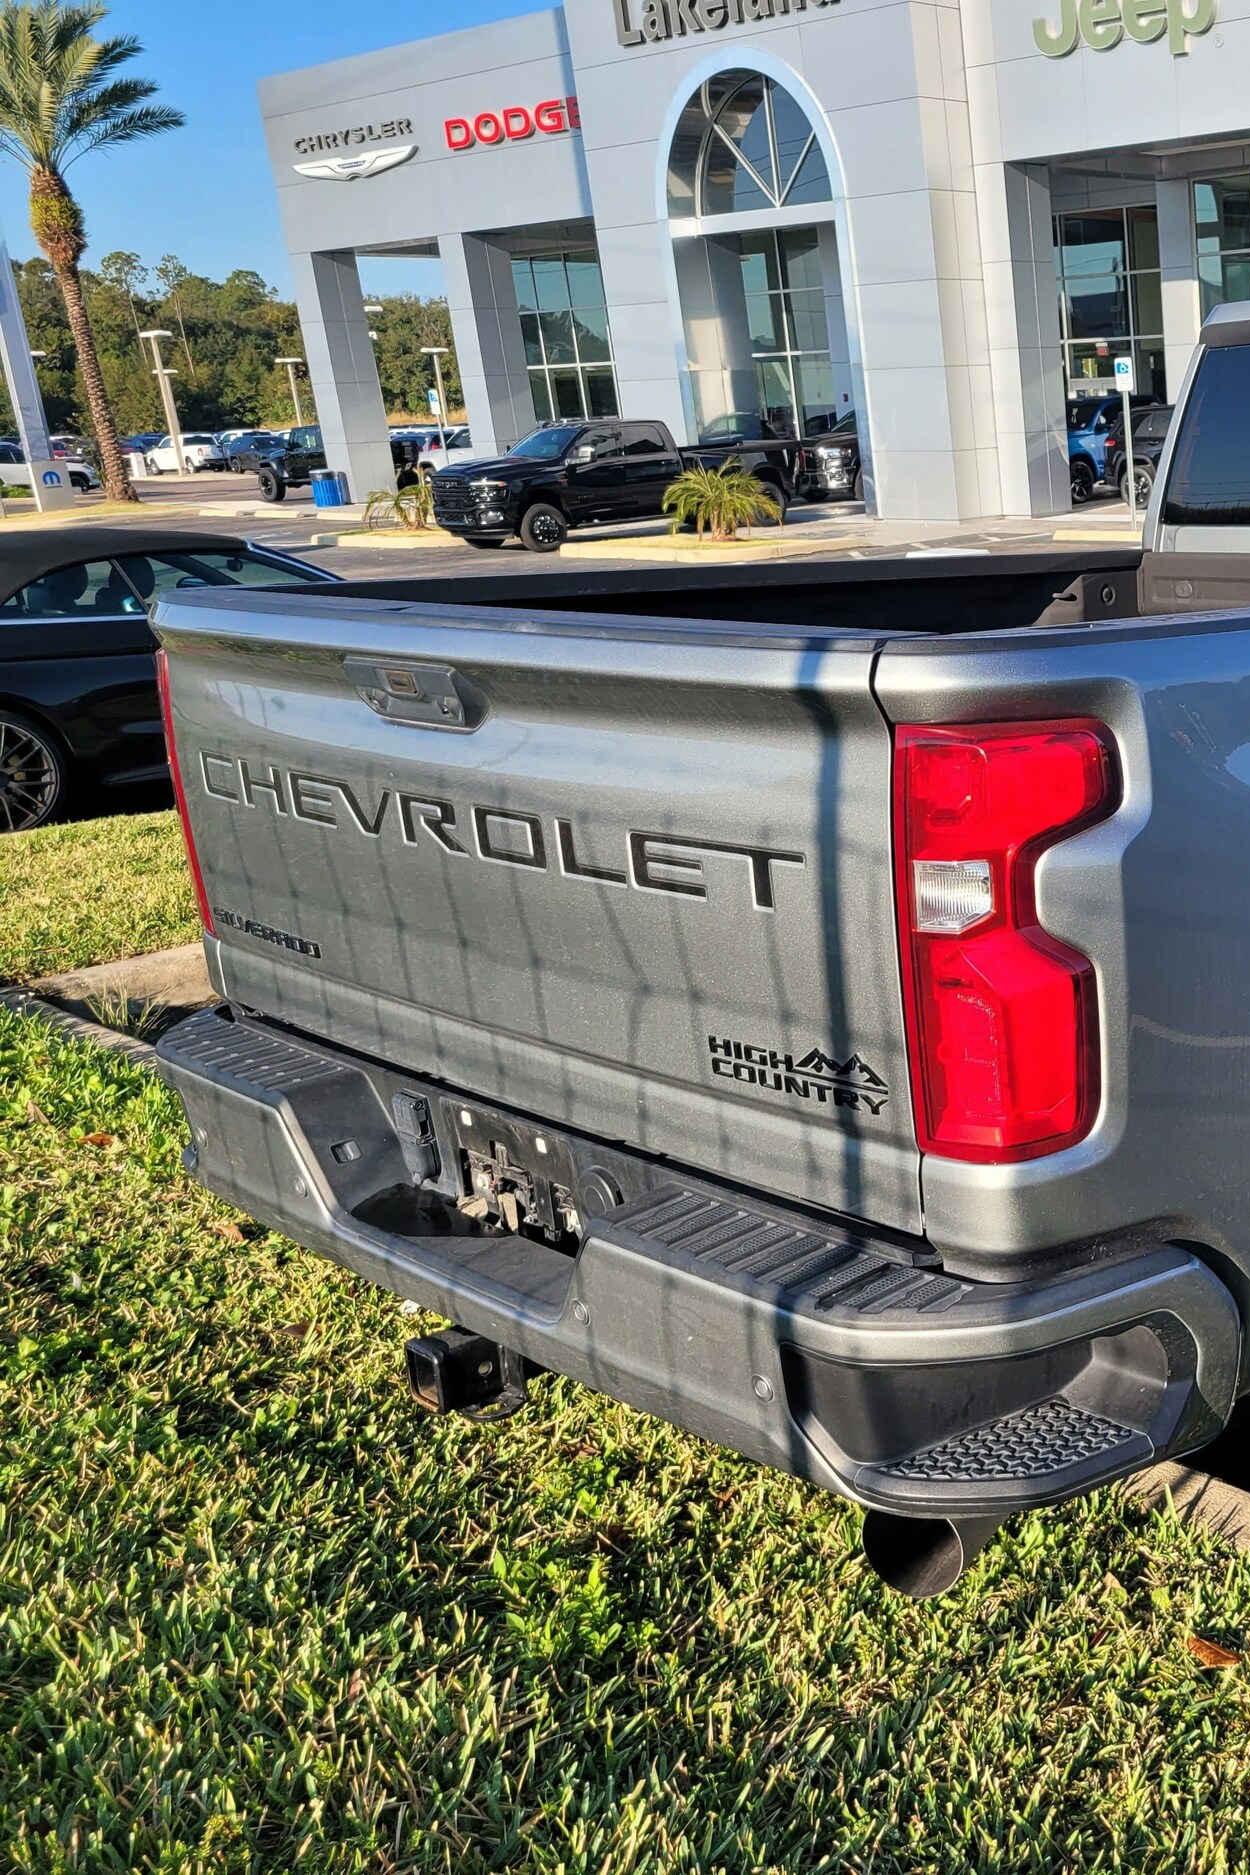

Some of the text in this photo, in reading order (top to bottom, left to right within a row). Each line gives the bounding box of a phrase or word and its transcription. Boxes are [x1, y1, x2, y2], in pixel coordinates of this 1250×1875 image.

[612, 0, 838, 46] Lake
[1032, 0, 1215, 57] Jeep
[294, 119, 413, 154] CHRYSLER
[444, 96, 581, 149] DODGE
[200, 750, 805, 912] CHEVROLET
[213, 905, 321, 959] SILVERADO
[708, 1035, 793, 1072] HIGH
[711, 1057, 890, 1115] COUNTRY
